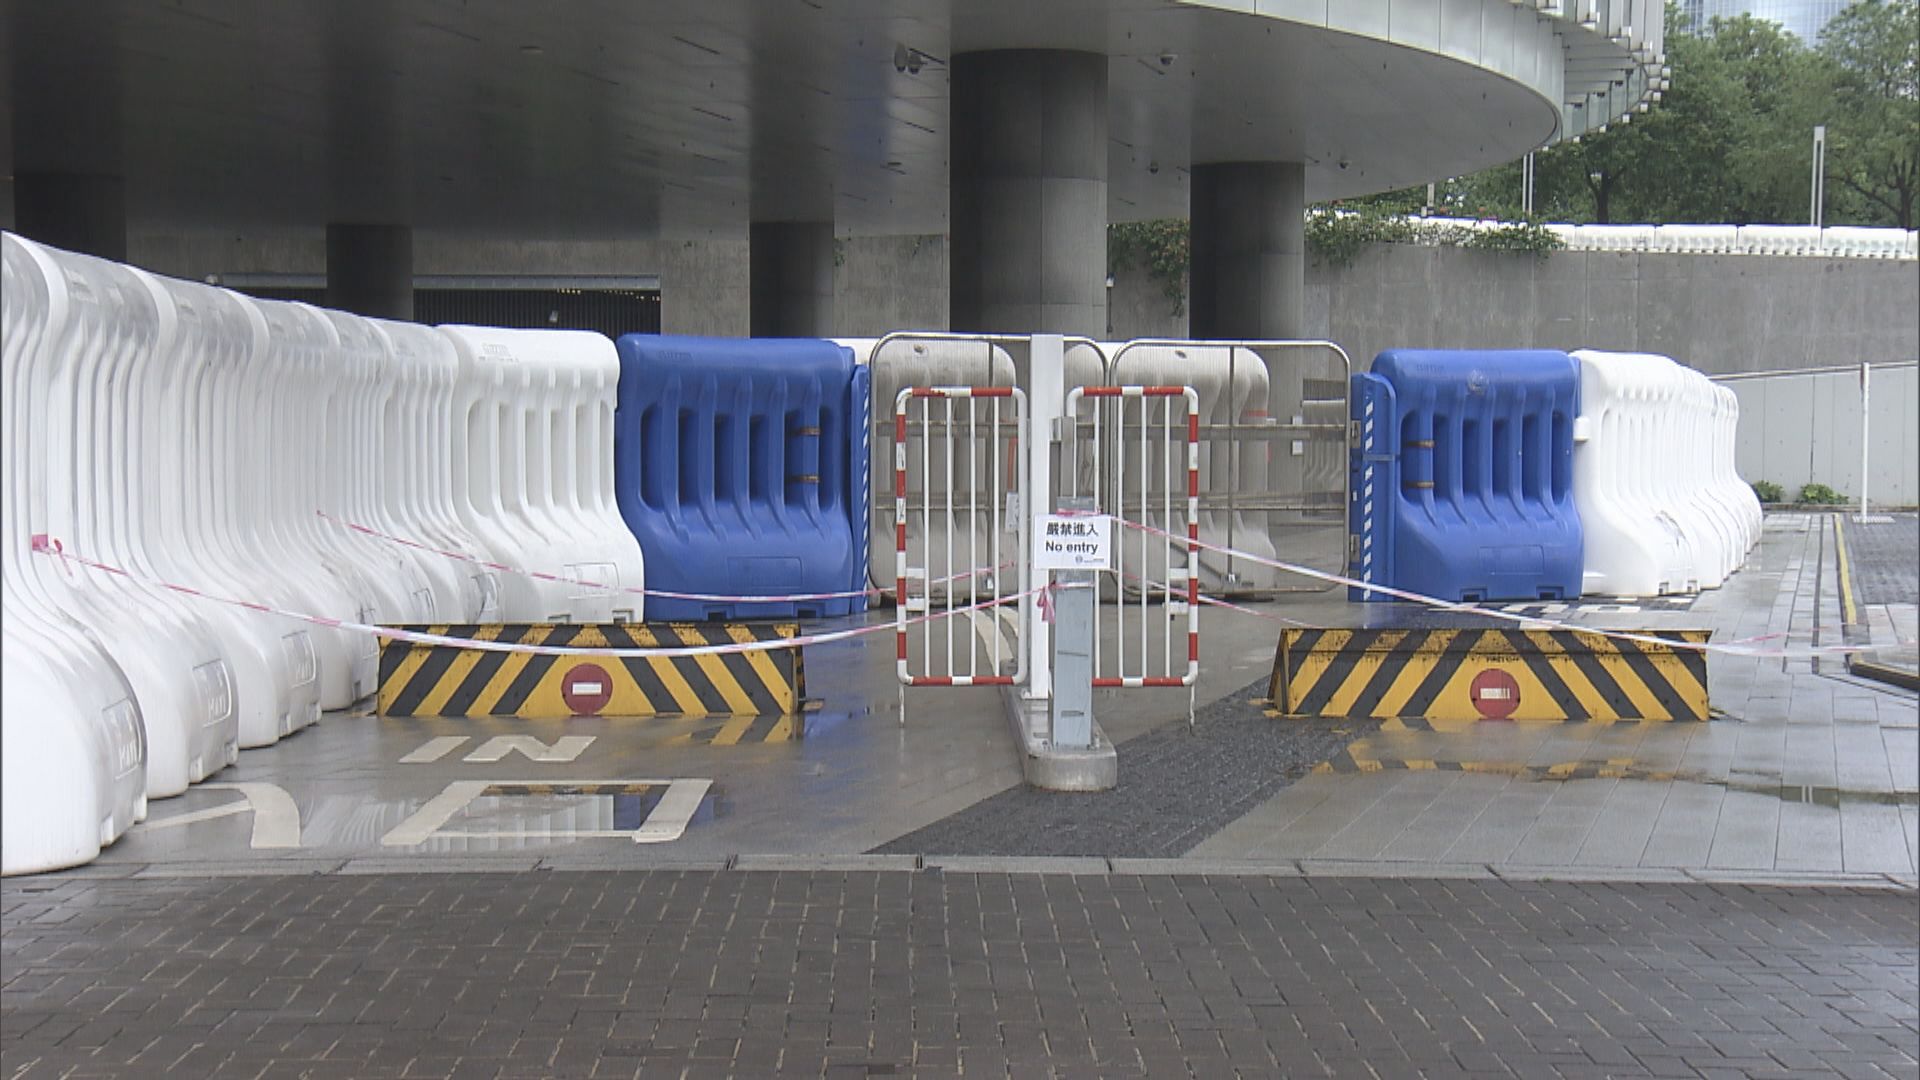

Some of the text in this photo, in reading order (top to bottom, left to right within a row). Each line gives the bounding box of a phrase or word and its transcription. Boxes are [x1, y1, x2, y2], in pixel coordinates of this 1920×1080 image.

[1047, 523, 1098, 536] 嚴禁進入
[1046, 541, 1098, 554] No entry
[397, 735, 597, 763] IN
